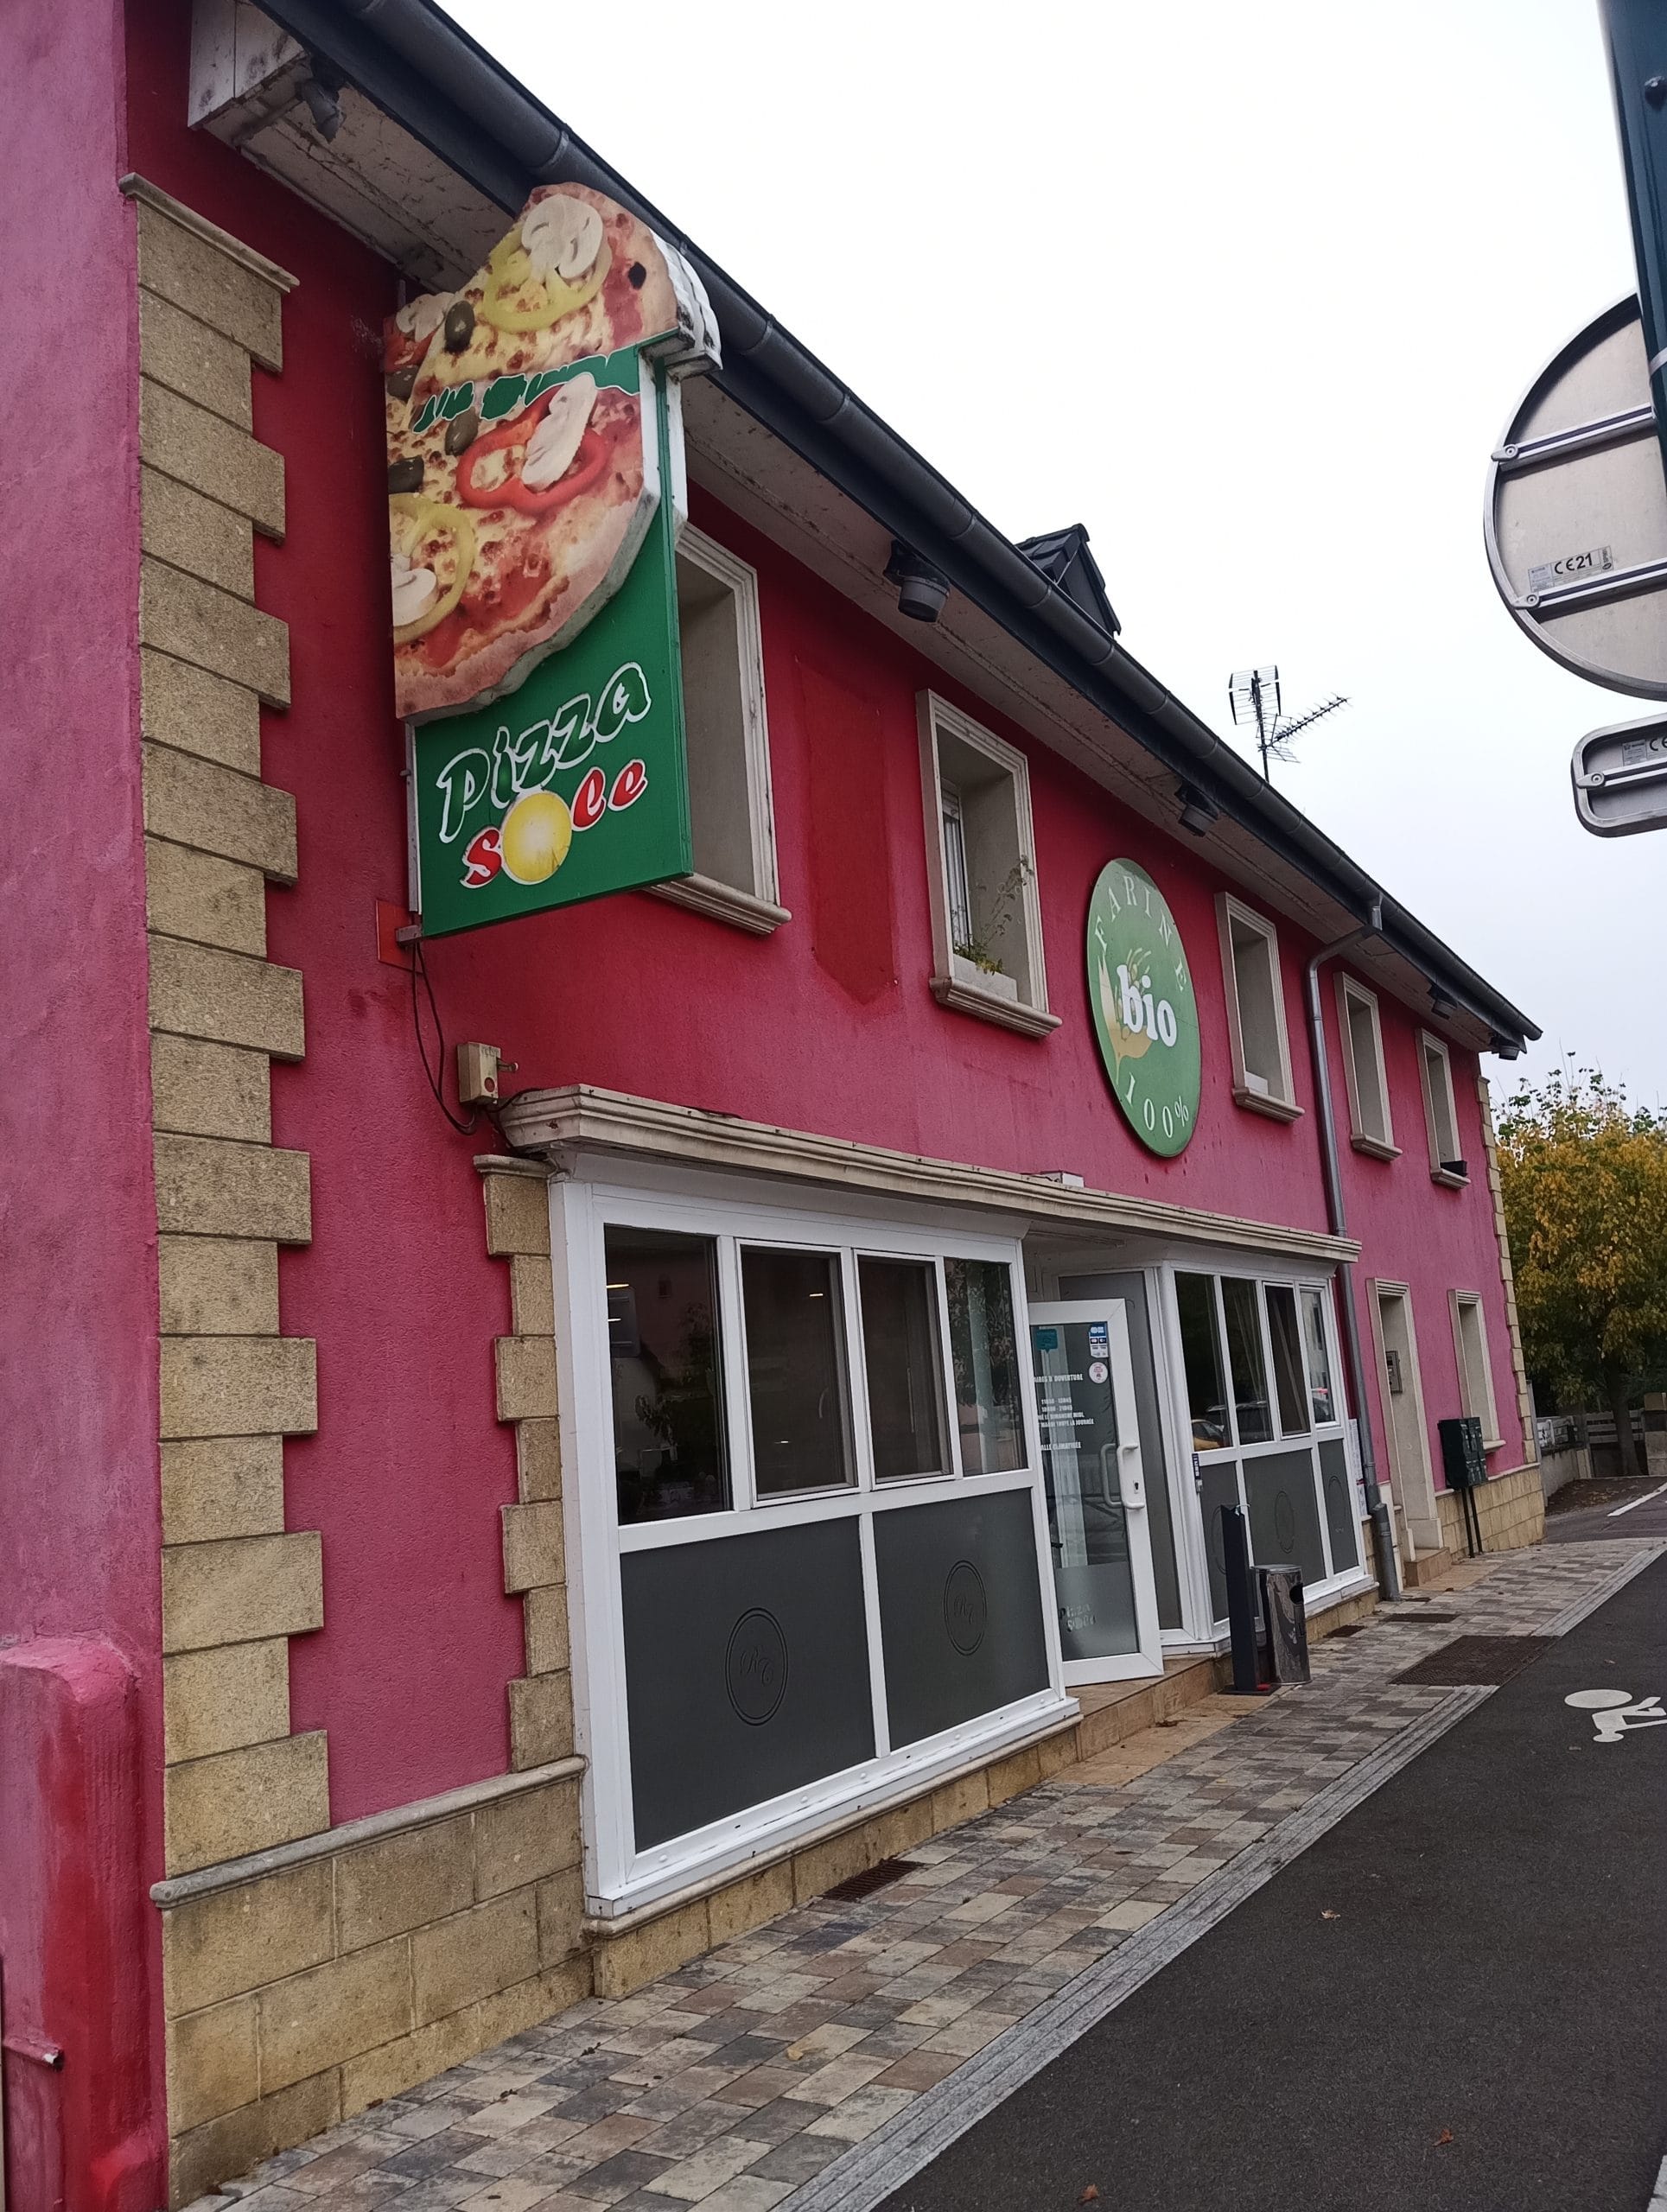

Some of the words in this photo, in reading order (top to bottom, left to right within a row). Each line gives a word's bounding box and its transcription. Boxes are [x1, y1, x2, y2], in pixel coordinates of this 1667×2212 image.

[436, 661, 652, 844] Pizza
[1094, 874, 1187, 992] FARINE
[1117, 964, 1178, 1048] bio
[1125, 1072, 1190, 1139] 100%
